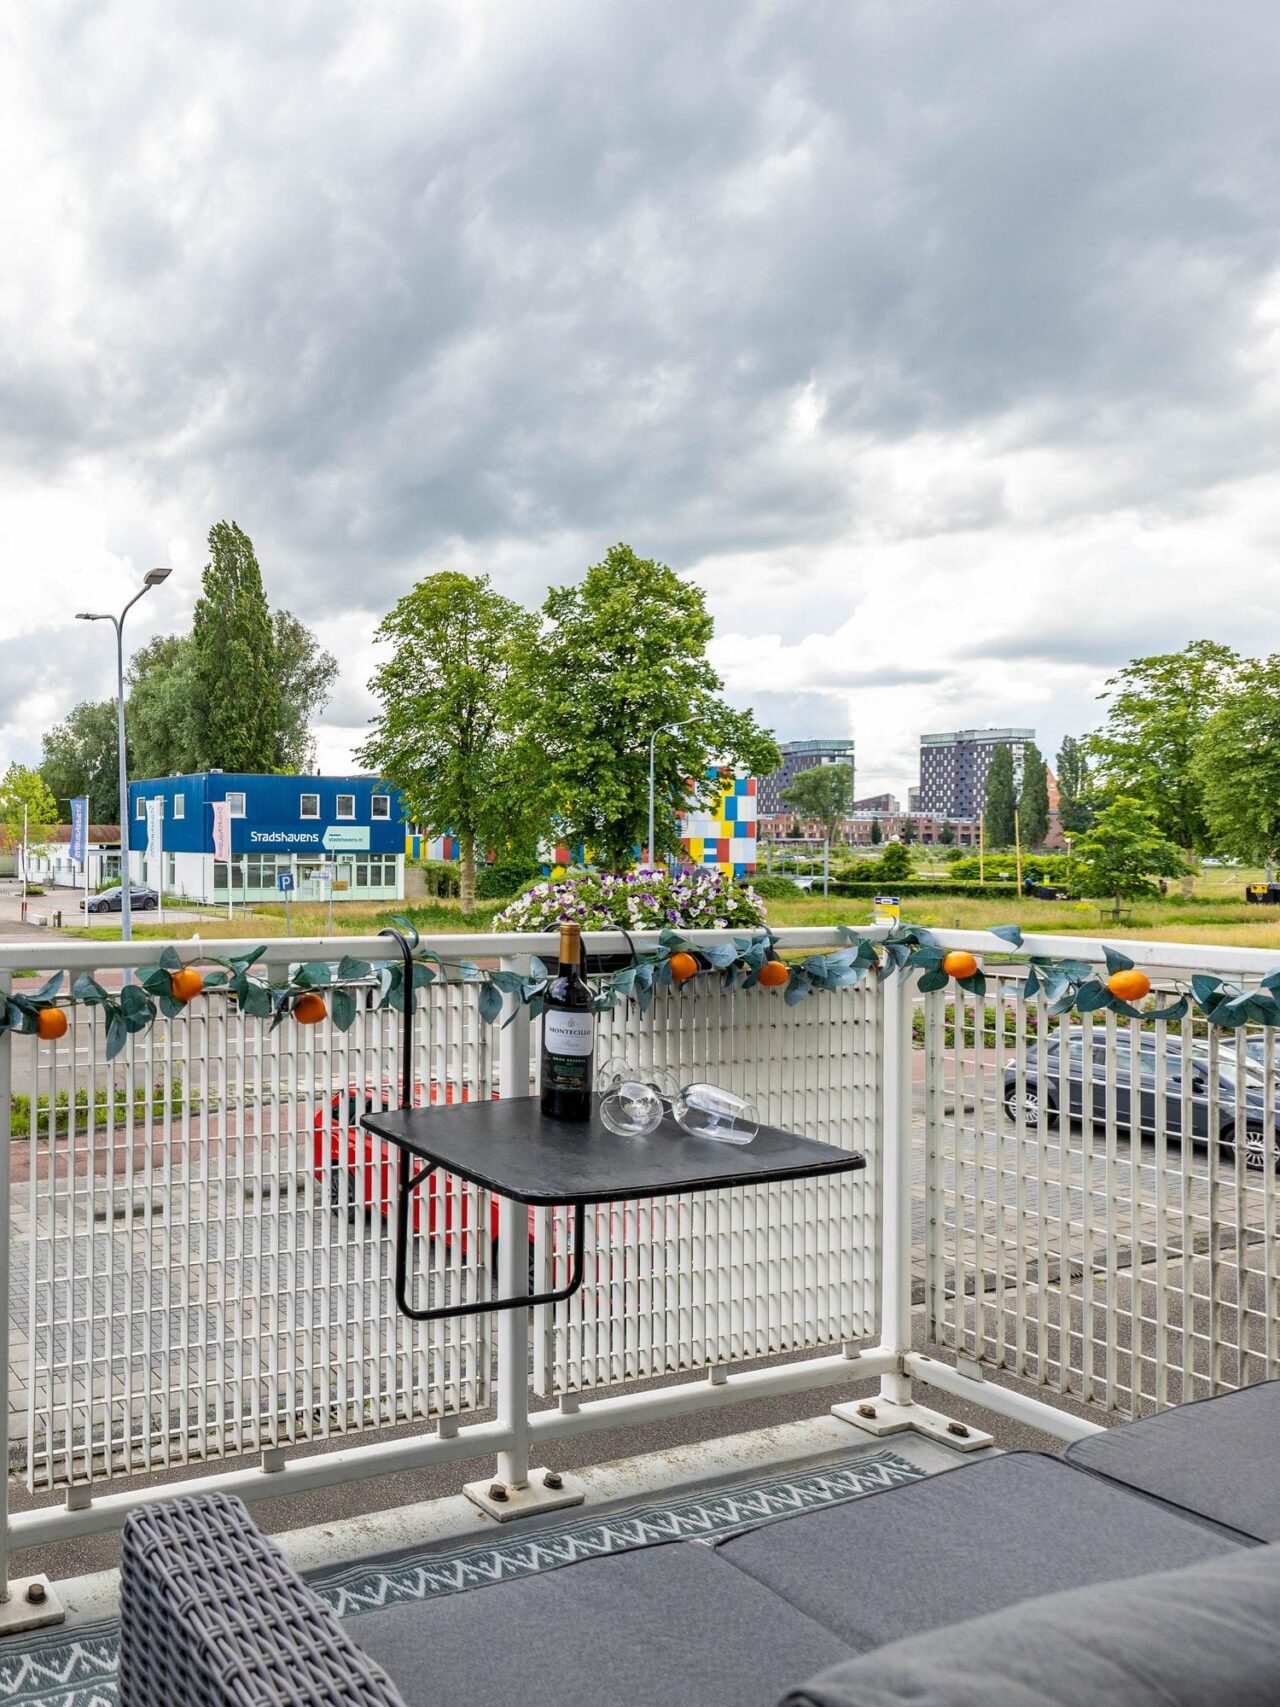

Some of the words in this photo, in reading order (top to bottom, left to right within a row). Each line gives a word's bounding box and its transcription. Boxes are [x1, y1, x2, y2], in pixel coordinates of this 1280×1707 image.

[251, 831, 319, 843] Stadshavens
[282, 876, 291, 890] P
[549, 1027, 591, 1035] MONTECILLO
